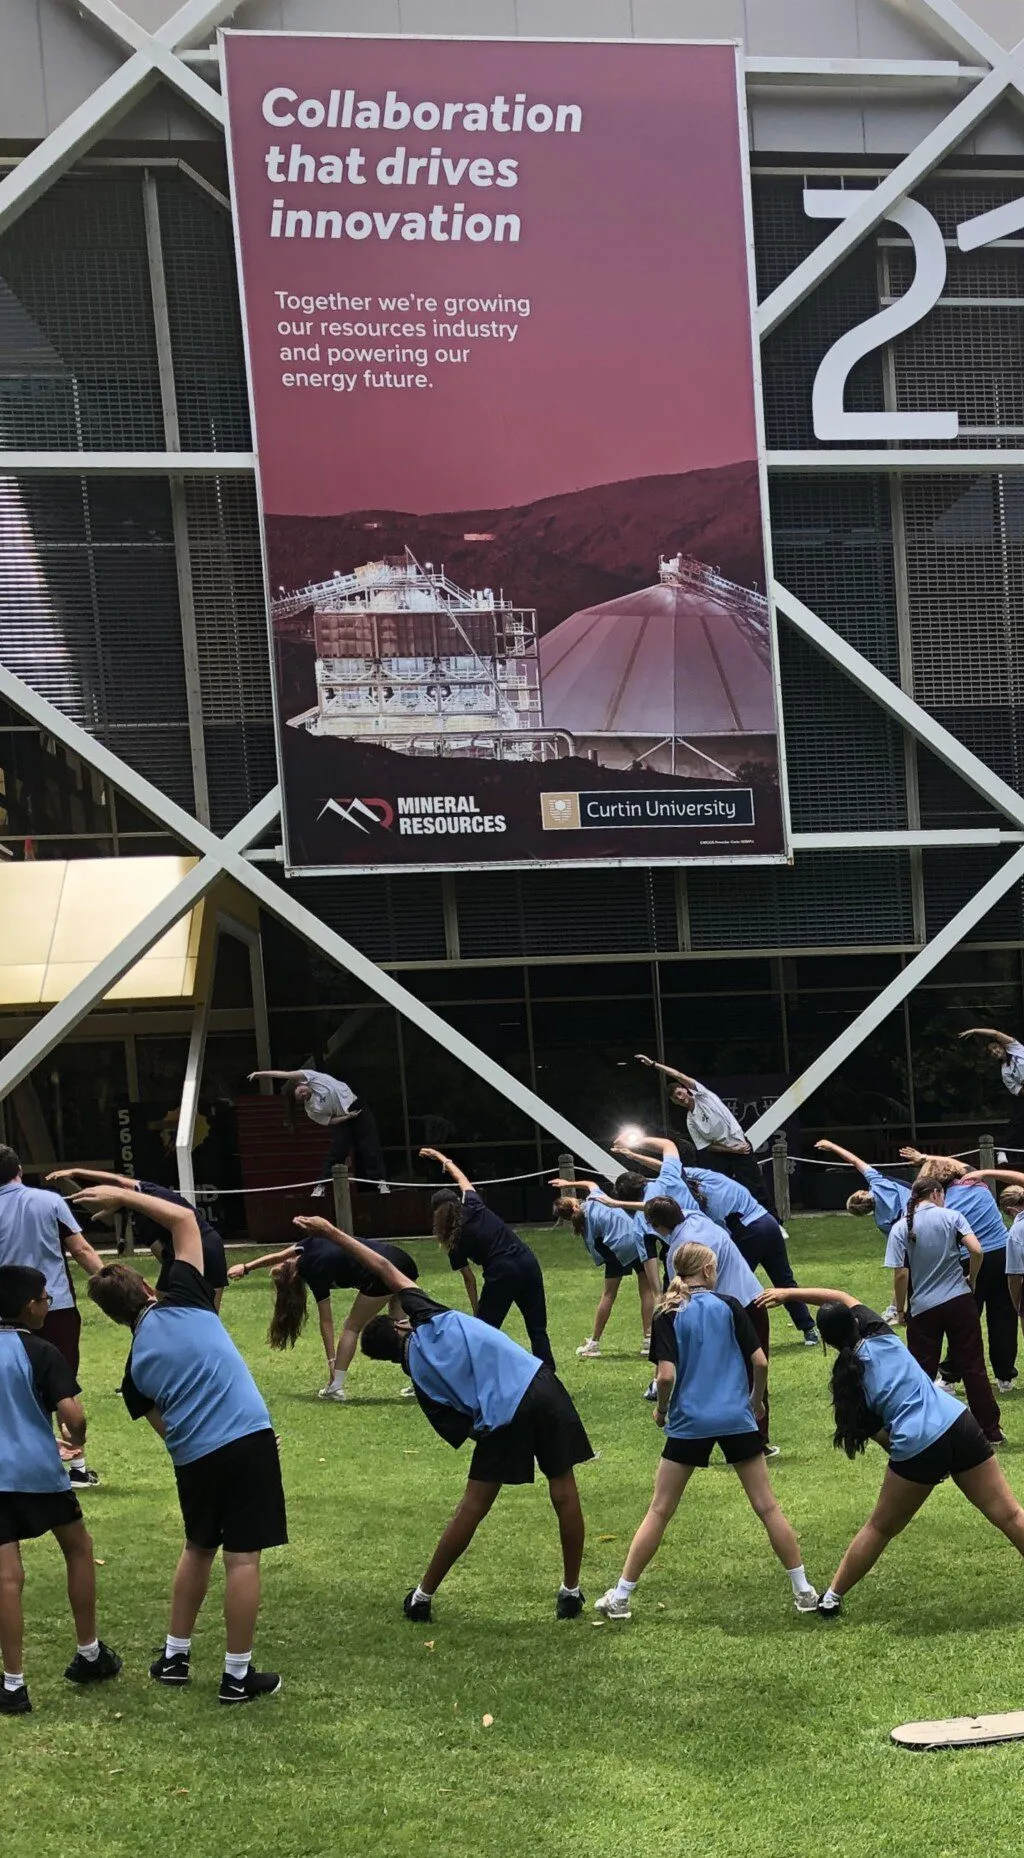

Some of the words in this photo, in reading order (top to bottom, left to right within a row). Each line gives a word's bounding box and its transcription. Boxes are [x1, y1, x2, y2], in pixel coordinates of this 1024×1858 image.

[262, 87, 582, 133] Collaboration
[265, 144, 366, 184] that
[376, 147, 519, 187] drives
[270, 199, 521, 242] innovation
[274, 291, 372, 315] Together
[378, 294, 437, 312] we’re
[444, 294, 531, 317] growing
[277, 321, 314, 336] our
[320, 322, 426, 337] resources
[432, 319, 519, 342] industry
[279, 344, 320, 362] and
[327, 345, 428, 367] powering
[434, 349, 470, 363] our
[281, 372, 358, 392] energy
[363, 370, 434, 388] future.
[397, 796, 480, 814] MINERAL
[586, 800, 642, 818] Curtin
[646, 796, 737, 819] University
[399, 814, 507, 835] RESOURCES
